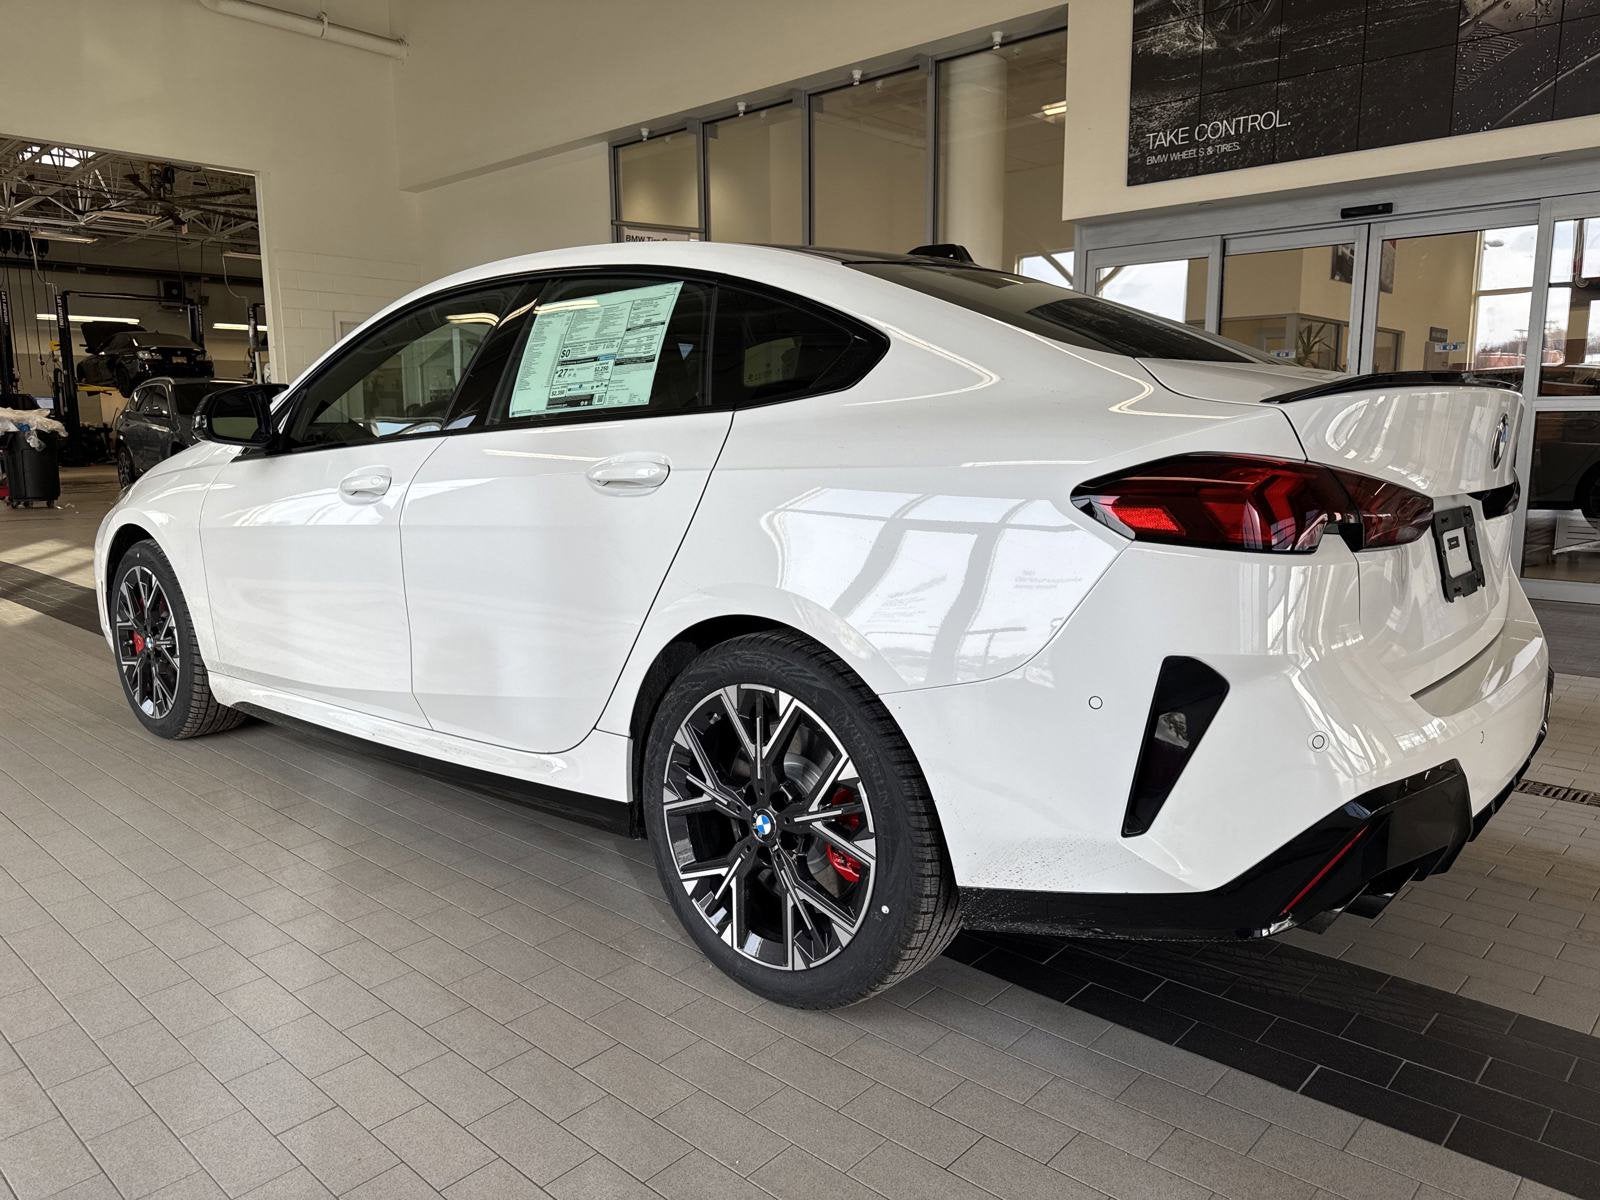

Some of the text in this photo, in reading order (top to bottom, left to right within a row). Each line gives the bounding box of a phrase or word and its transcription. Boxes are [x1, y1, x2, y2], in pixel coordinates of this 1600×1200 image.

[1145, 109, 1291, 150] TAKE CONTROL.
[1146, 153, 1168, 165] BMW
[1169, 148, 1205, 162] WHEELS
[1206, 146, 1213, 156] &
[625, 234, 645, 242] BMW
